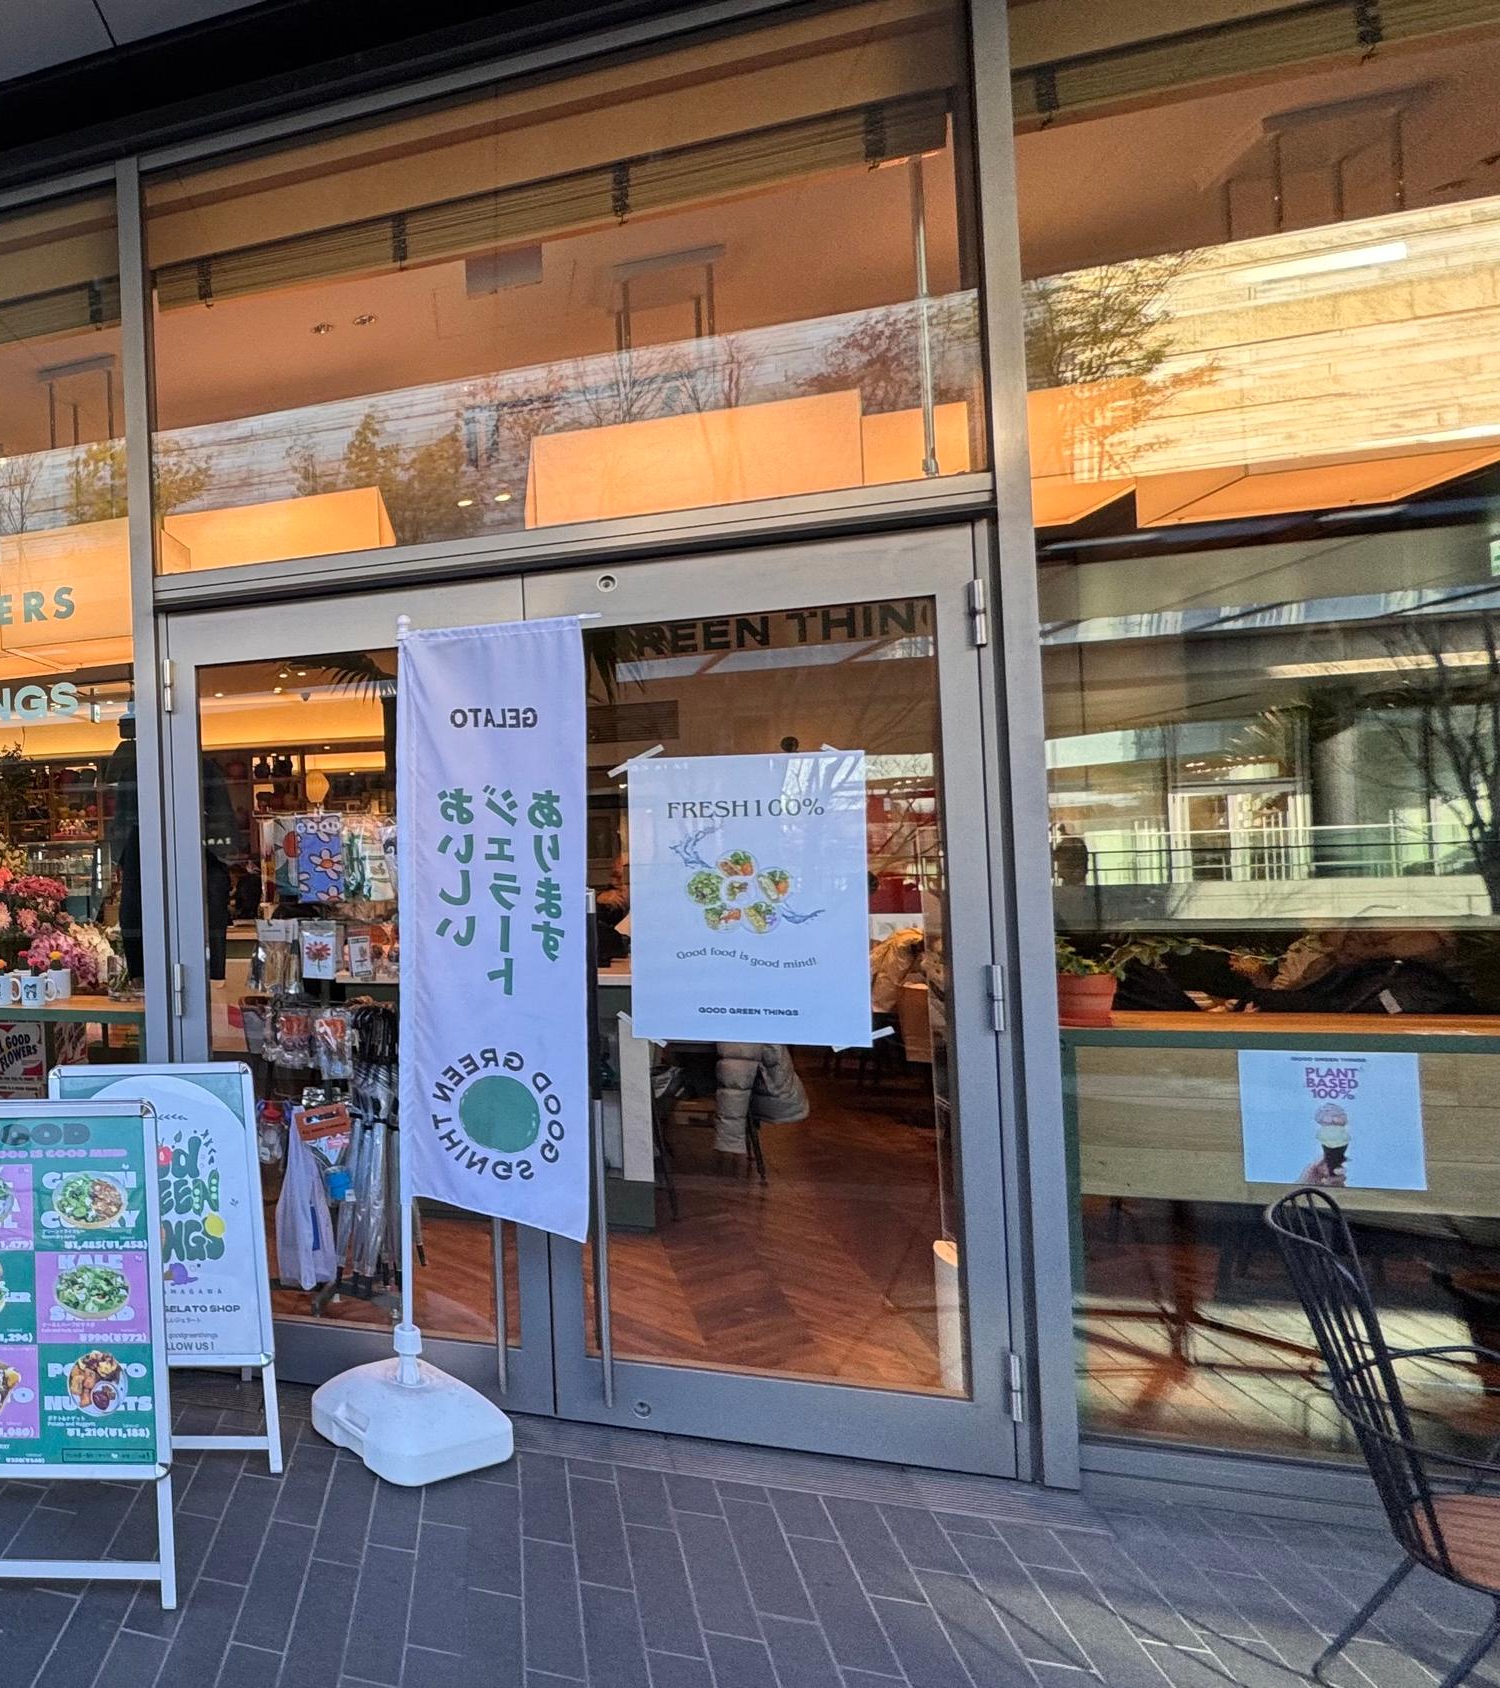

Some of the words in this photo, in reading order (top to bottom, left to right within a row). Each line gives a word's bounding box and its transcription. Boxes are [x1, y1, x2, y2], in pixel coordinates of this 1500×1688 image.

[637, 615, 770, 657] REEN
[786, 602, 929, 643] THIN
[676, 948, 707, 960] Good
[710, 947, 737, 958] food
[739, 951, 749, 961] is
[750, 957, 780, 968] good
[783, 957, 818, 969] mind!
[698, 1006, 727, 1014] GOOD
[763, 1008, 799, 1017] THINGS
[5, 1033, 31, 1048] GOOD
[0, 1044, 38, 1072] FLOWERS
[1305, 1067, 1358, 1078] PLANT
[1306, 1078, 1358, 1089] BASED
[1311, 1088, 1355, 1100] 100%
[58, 1254, 123, 1269] KALE
[209, 1305, 241, 1313] SHOP
